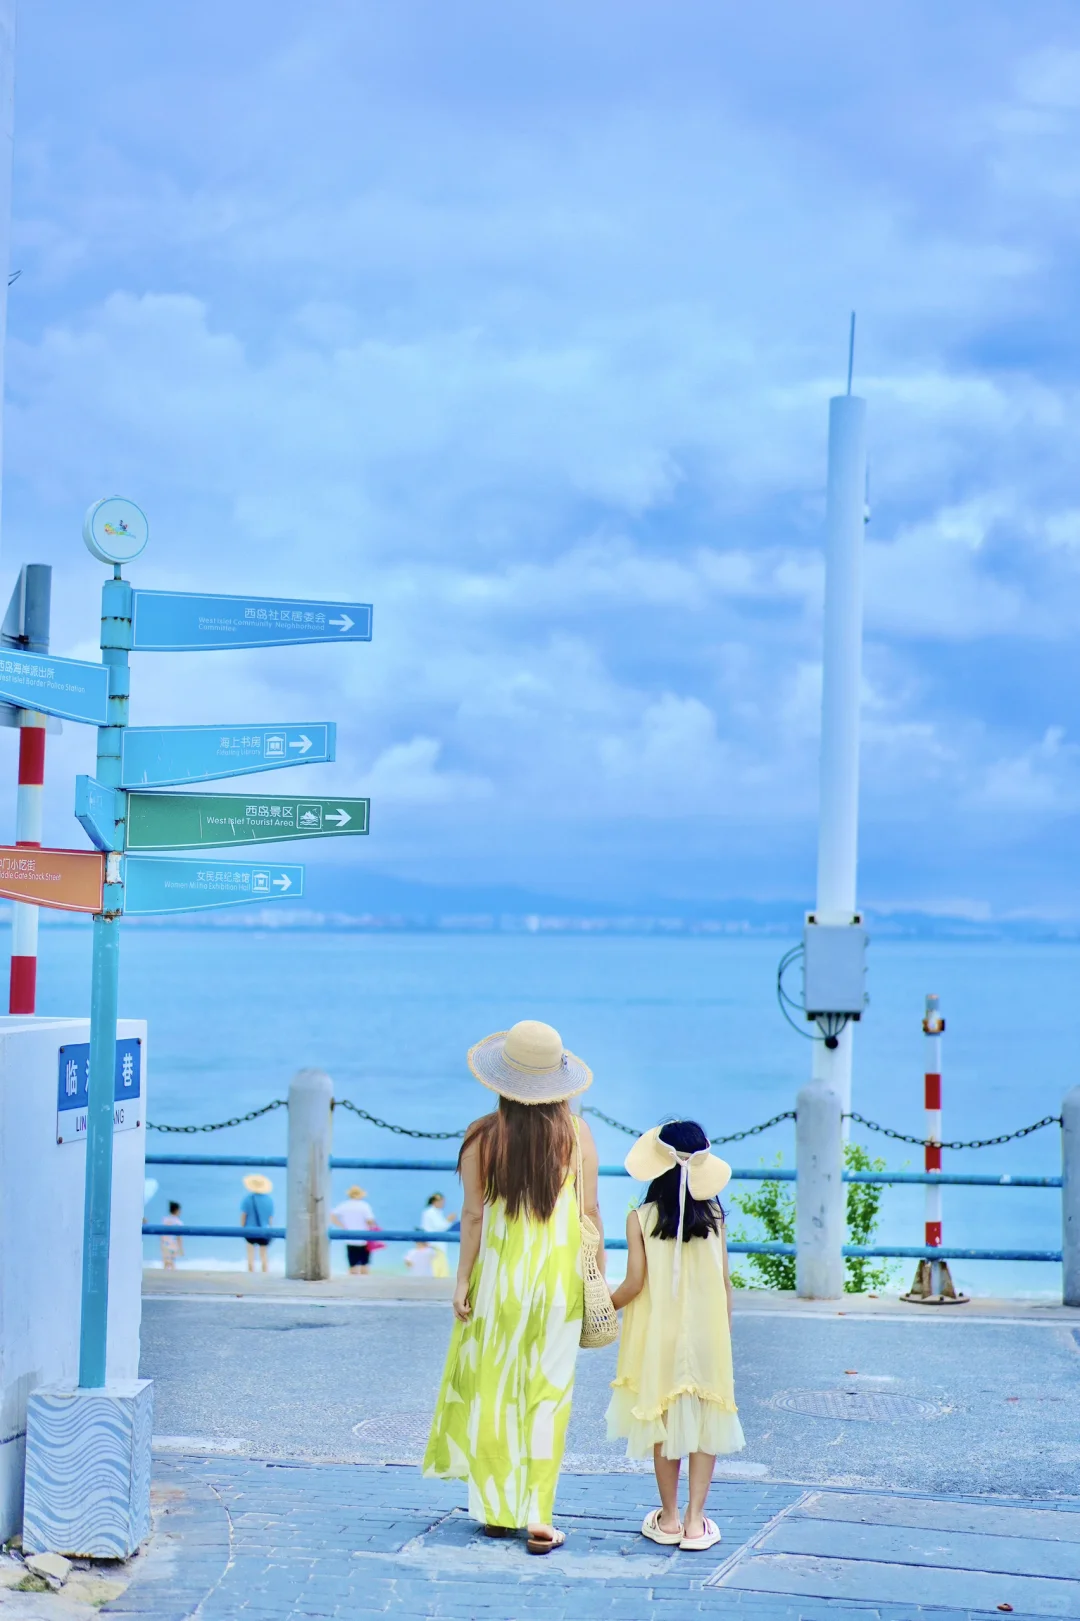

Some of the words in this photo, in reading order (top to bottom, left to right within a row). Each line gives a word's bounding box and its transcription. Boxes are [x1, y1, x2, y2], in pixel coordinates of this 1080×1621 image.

[245, 607, 326, 623] 西岛社区居委会
[198, 616, 216, 624] West
[233, 618, 272, 629] Community
[275, 620, 325, 631] Neighborhood
[198, 624, 236, 632] Committee
[26, 678, 46, 688] Border
[47, 681, 65, 690] Police
[65, 684, 86, 693] Station
[220, 735, 261, 749] 海上书房
[240, 748, 261, 757] Library
[245, 805, 294, 818] 西岛景区
[206, 816, 227, 824] West
[246, 818, 273, 826] Tourist
[274, 819, 294, 827] Area
[0, 858, 36, 871] 门小吃街
[14, 871, 28, 880] Gate
[28, 872, 45, 881] Snack
[45, 872, 61, 881] Street
[196, 869, 251, 884] 女民兵纪念馆
[208, 882, 238, 891] Exhibition
[238, 883, 251, 891] Hall
